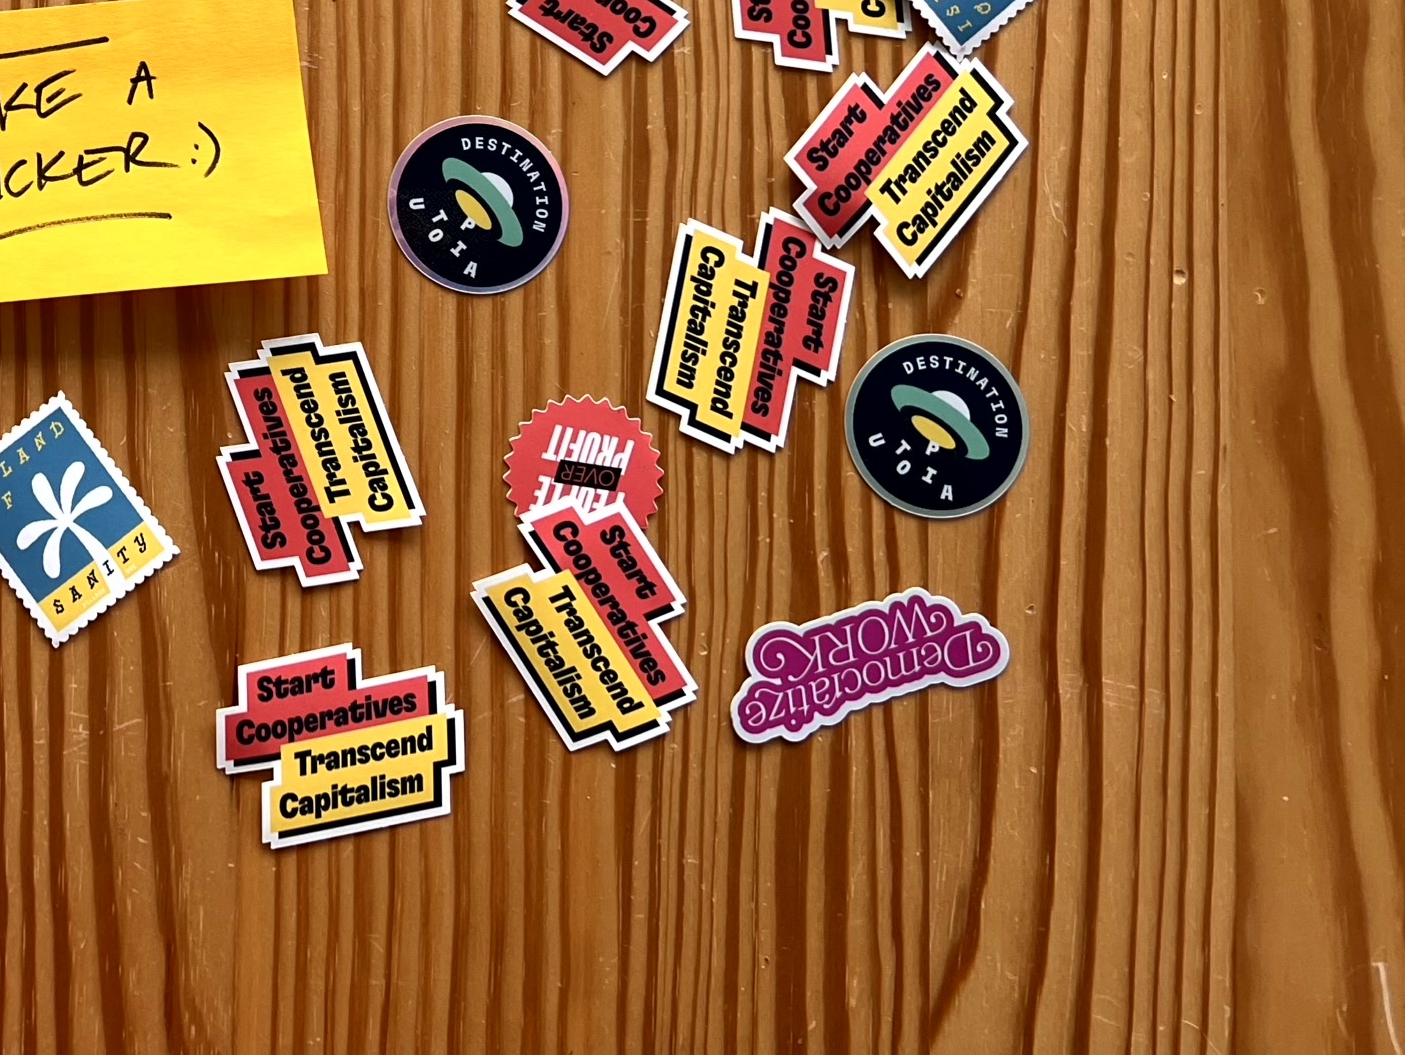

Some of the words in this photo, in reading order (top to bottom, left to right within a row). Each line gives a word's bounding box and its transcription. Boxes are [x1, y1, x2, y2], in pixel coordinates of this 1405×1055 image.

[126, 59, 158, 106] A
[806, 102, 868, 172] Start
[818, 72, 942, 217] Cooperatives
[878, 86, 978, 205] Transcend
[461, 137, 549, 233] DESTINATION
[895, 129, 997, 247] Capitalism
[408, 197, 478, 279] UTOPIA
[676, 245, 726, 390] Capitalism
[709, 278, 759, 420] Transcend
[750, 235, 808, 417] Cooperatives
[801, 271, 839, 354] Start
[279, 366, 351, 504] Transcend
[902, 354, 1009, 438] DESTINATION
[252, 386, 332, 566] Cooperatives
[327, 371, 394, 513] Capitalism
[559, 462, 616, 488] OVER
[868, 432, 954, 502] UTOPIA
[241, 470, 287, 550] Start
[52, 532, 147, 614] SANITY
[553, 519, 667, 686] Cooperatives
[599, 524, 658, 600] Start
[503, 585, 597, 721] Capitalism
[547, 583, 645, 716] Transcend
[744, 627, 994, 727] Democratize
[759, 602, 948, 681] WORK
[235, 692, 417, 746] Cooperatives
[256, 665, 336, 703] Start
[293, 724, 433, 777] Transcend
[278, 772, 424, 820] Capitalism
